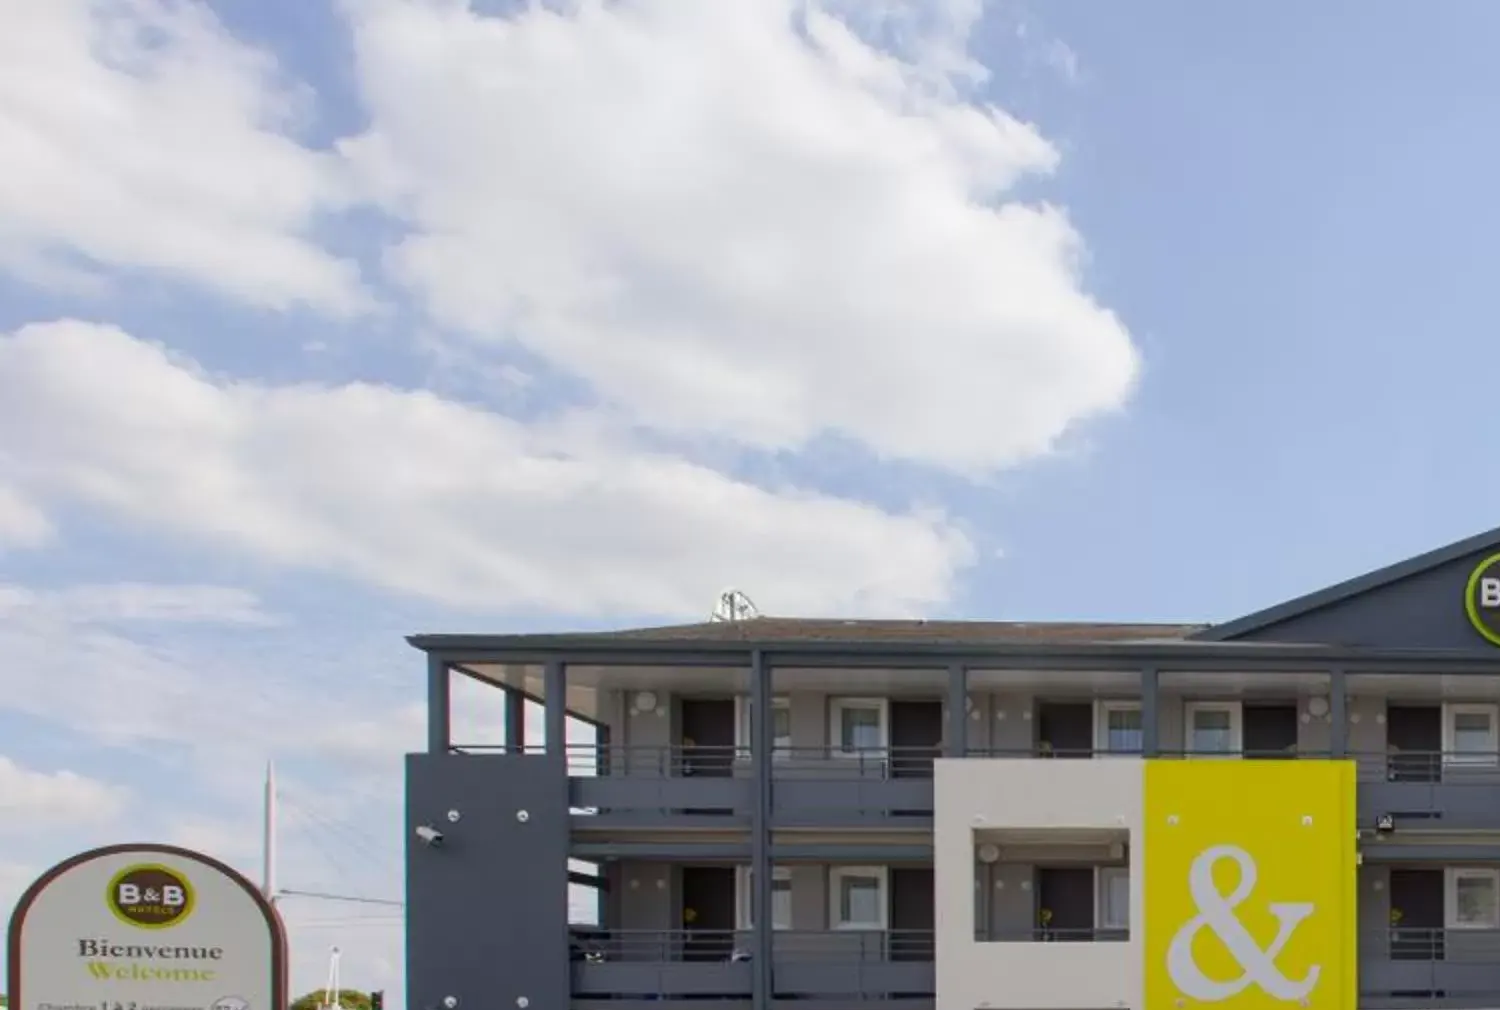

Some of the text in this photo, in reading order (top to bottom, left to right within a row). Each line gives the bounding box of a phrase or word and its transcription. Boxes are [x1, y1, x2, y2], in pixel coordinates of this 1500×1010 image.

[119, 883, 185, 906] B&B
[1166, 844, 1321, 1001] &
[78, 938, 224, 960] Bienvenue
[86, 961, 217, 981] Welcome
